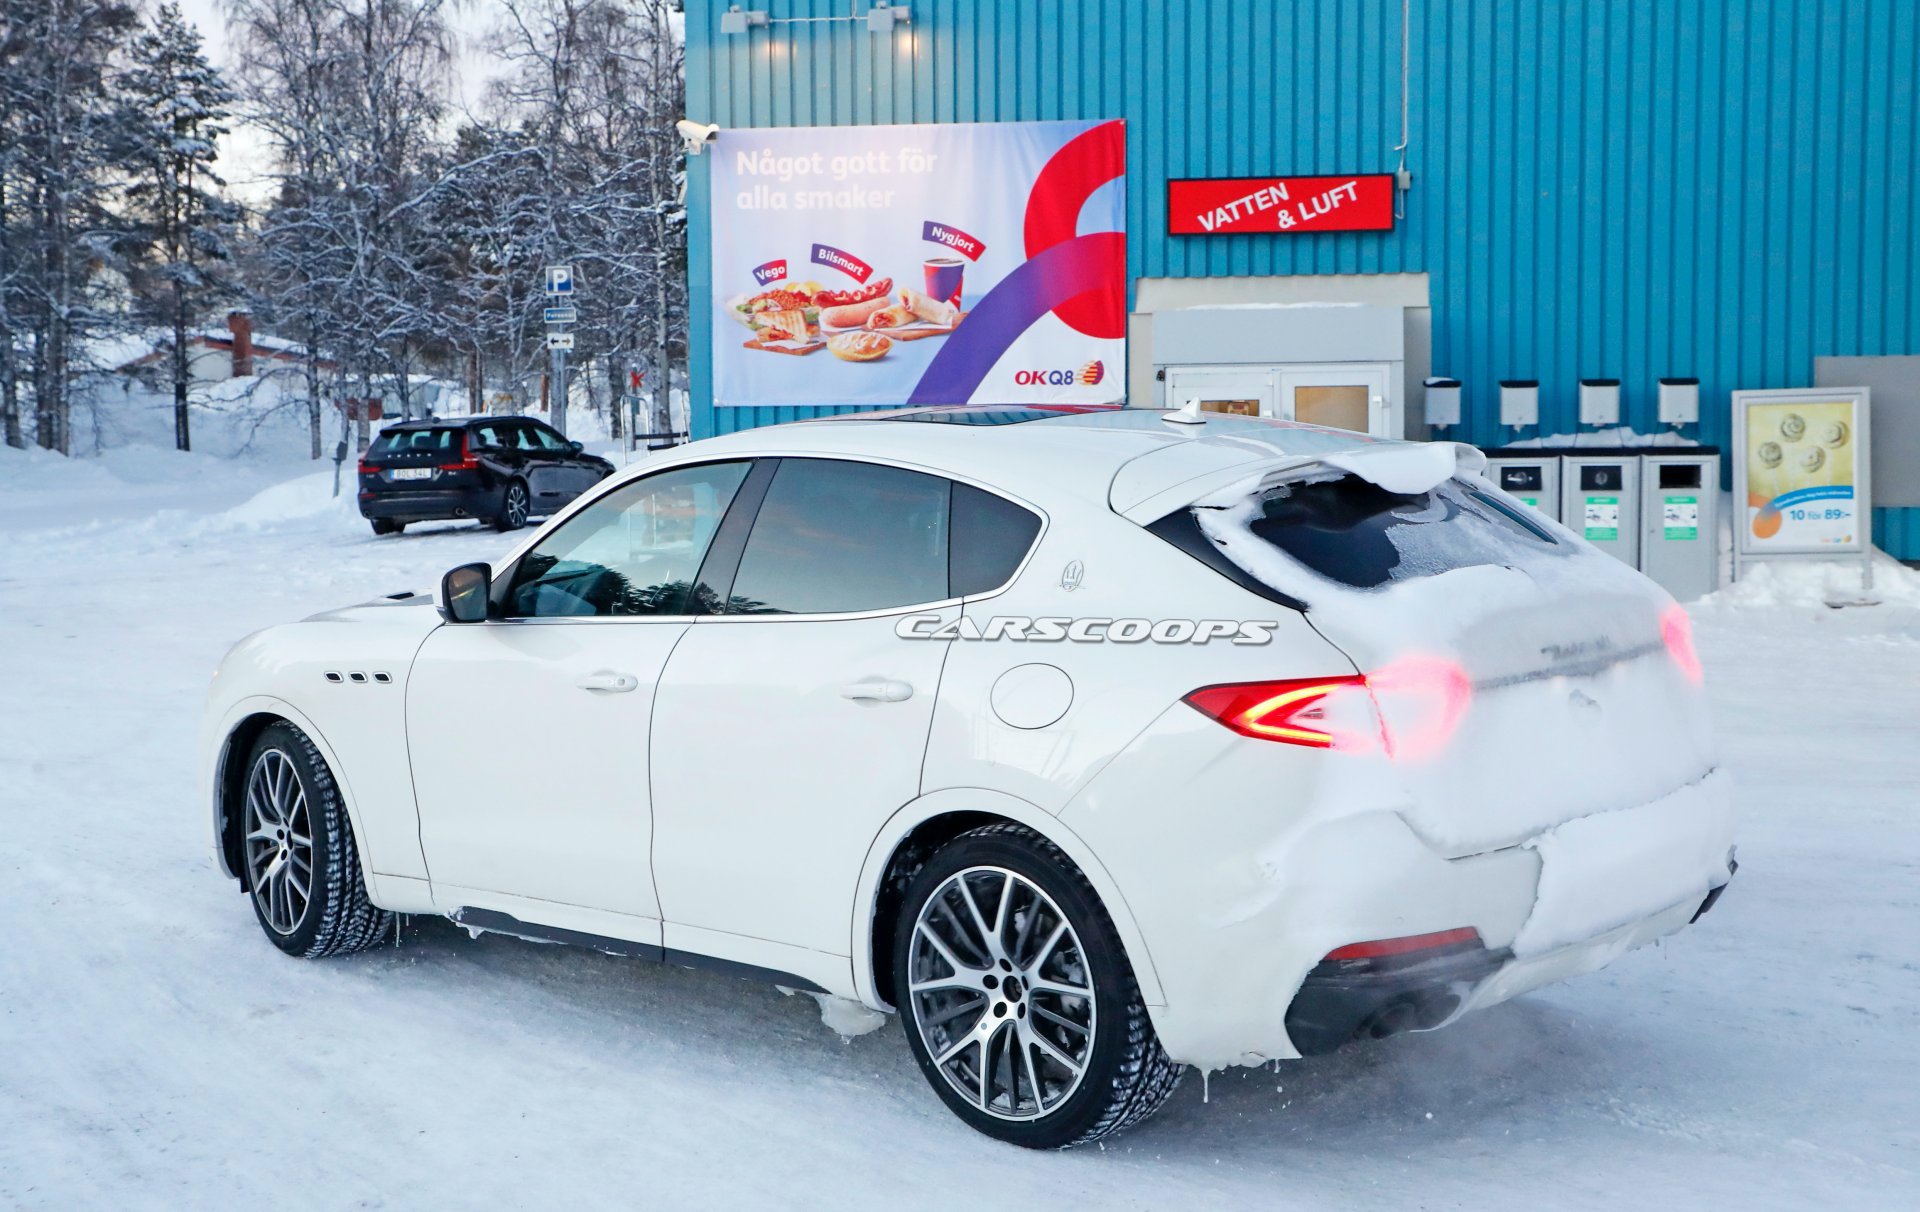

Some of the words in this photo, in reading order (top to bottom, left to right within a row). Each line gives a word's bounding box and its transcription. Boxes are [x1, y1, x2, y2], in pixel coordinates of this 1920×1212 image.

[736, 148, 823, 181] Något
[831, 151, 891, 181] gott
[898, 147, 938, 173] för
[736, 185, 788, 209] alla
[794, 184, 896, 208] smaker
[1197, 182, 1290, 231] VATTEN
[1277, 209, 1297, 229] &
[1297, 181, 1358, 221] LUFT
[931, 226, 975, 253] Nygjort
[756, 265, 786, 281] Vego
[818, 248, 864, 277] Bilsmart
[553, 269, 568, 292] P
[1790, 509, 1806, 520] 10
